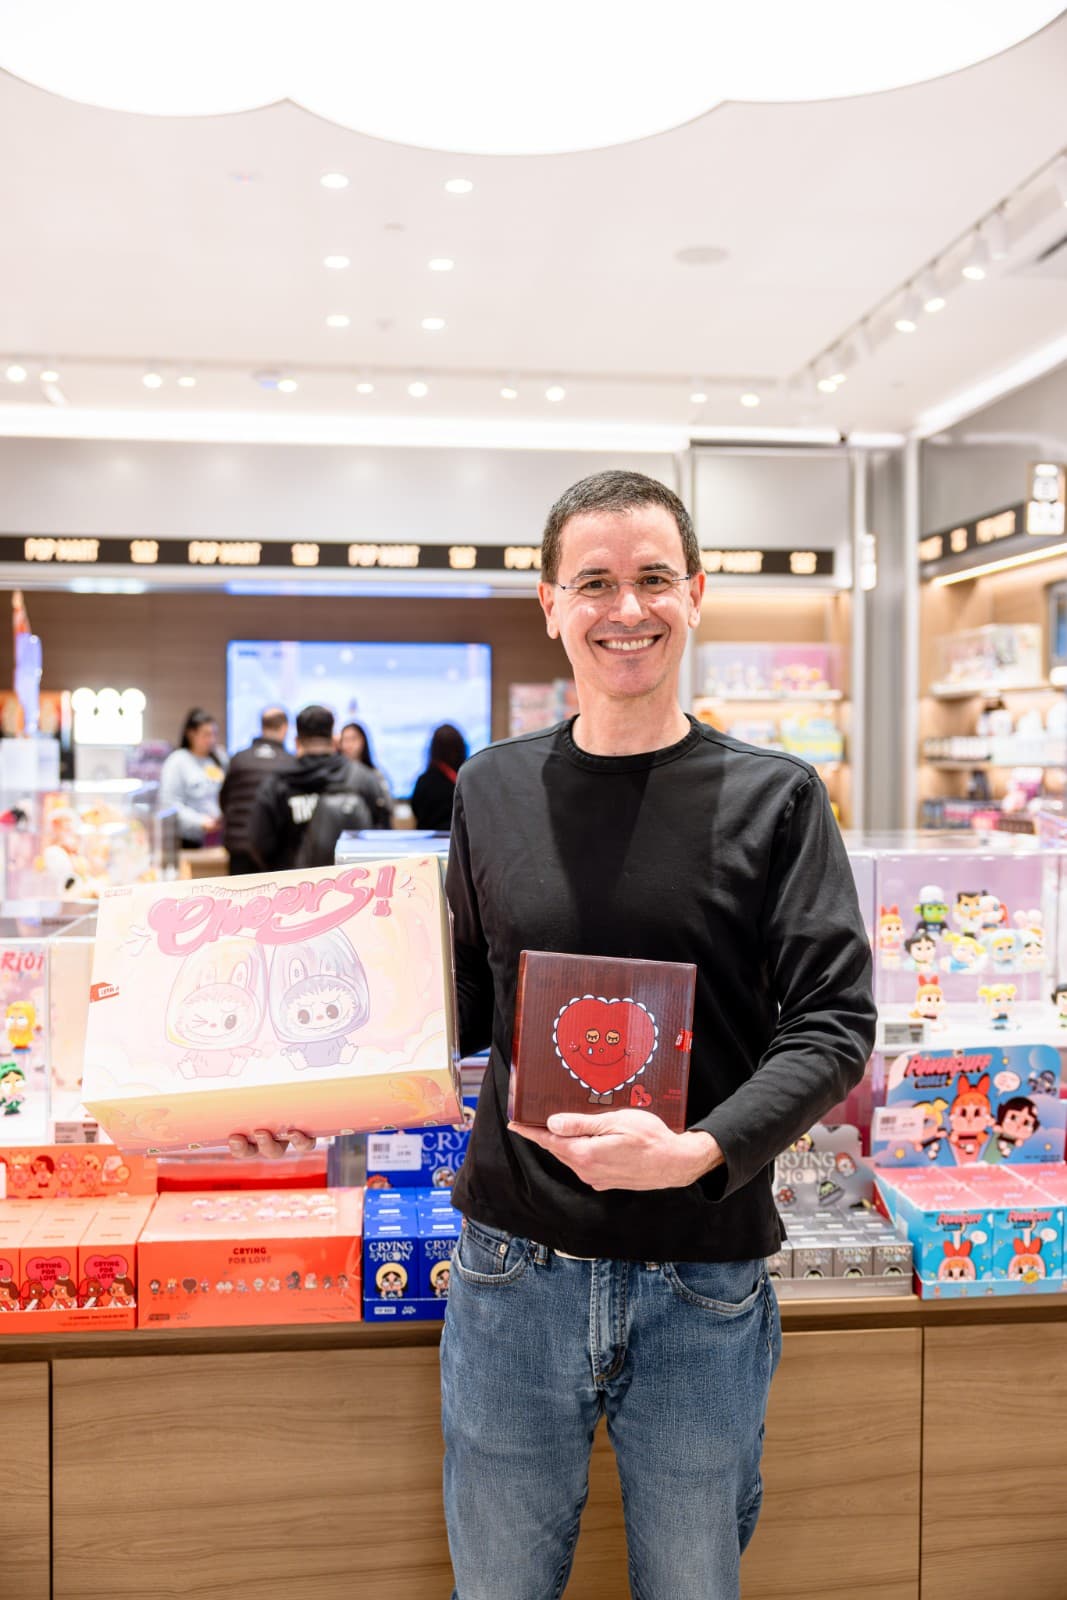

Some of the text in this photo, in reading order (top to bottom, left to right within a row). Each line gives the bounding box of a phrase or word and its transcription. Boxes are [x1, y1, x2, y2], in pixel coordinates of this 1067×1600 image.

[148, 865, 396, 956] Cheers!
[779, 1151, 836, 1169] RYING
[232, 1247, 267, 1255] CRYING
[368, 1240, 414, 1253] CRYING
[228, 1255, 272, 1265] FOR LOVE
